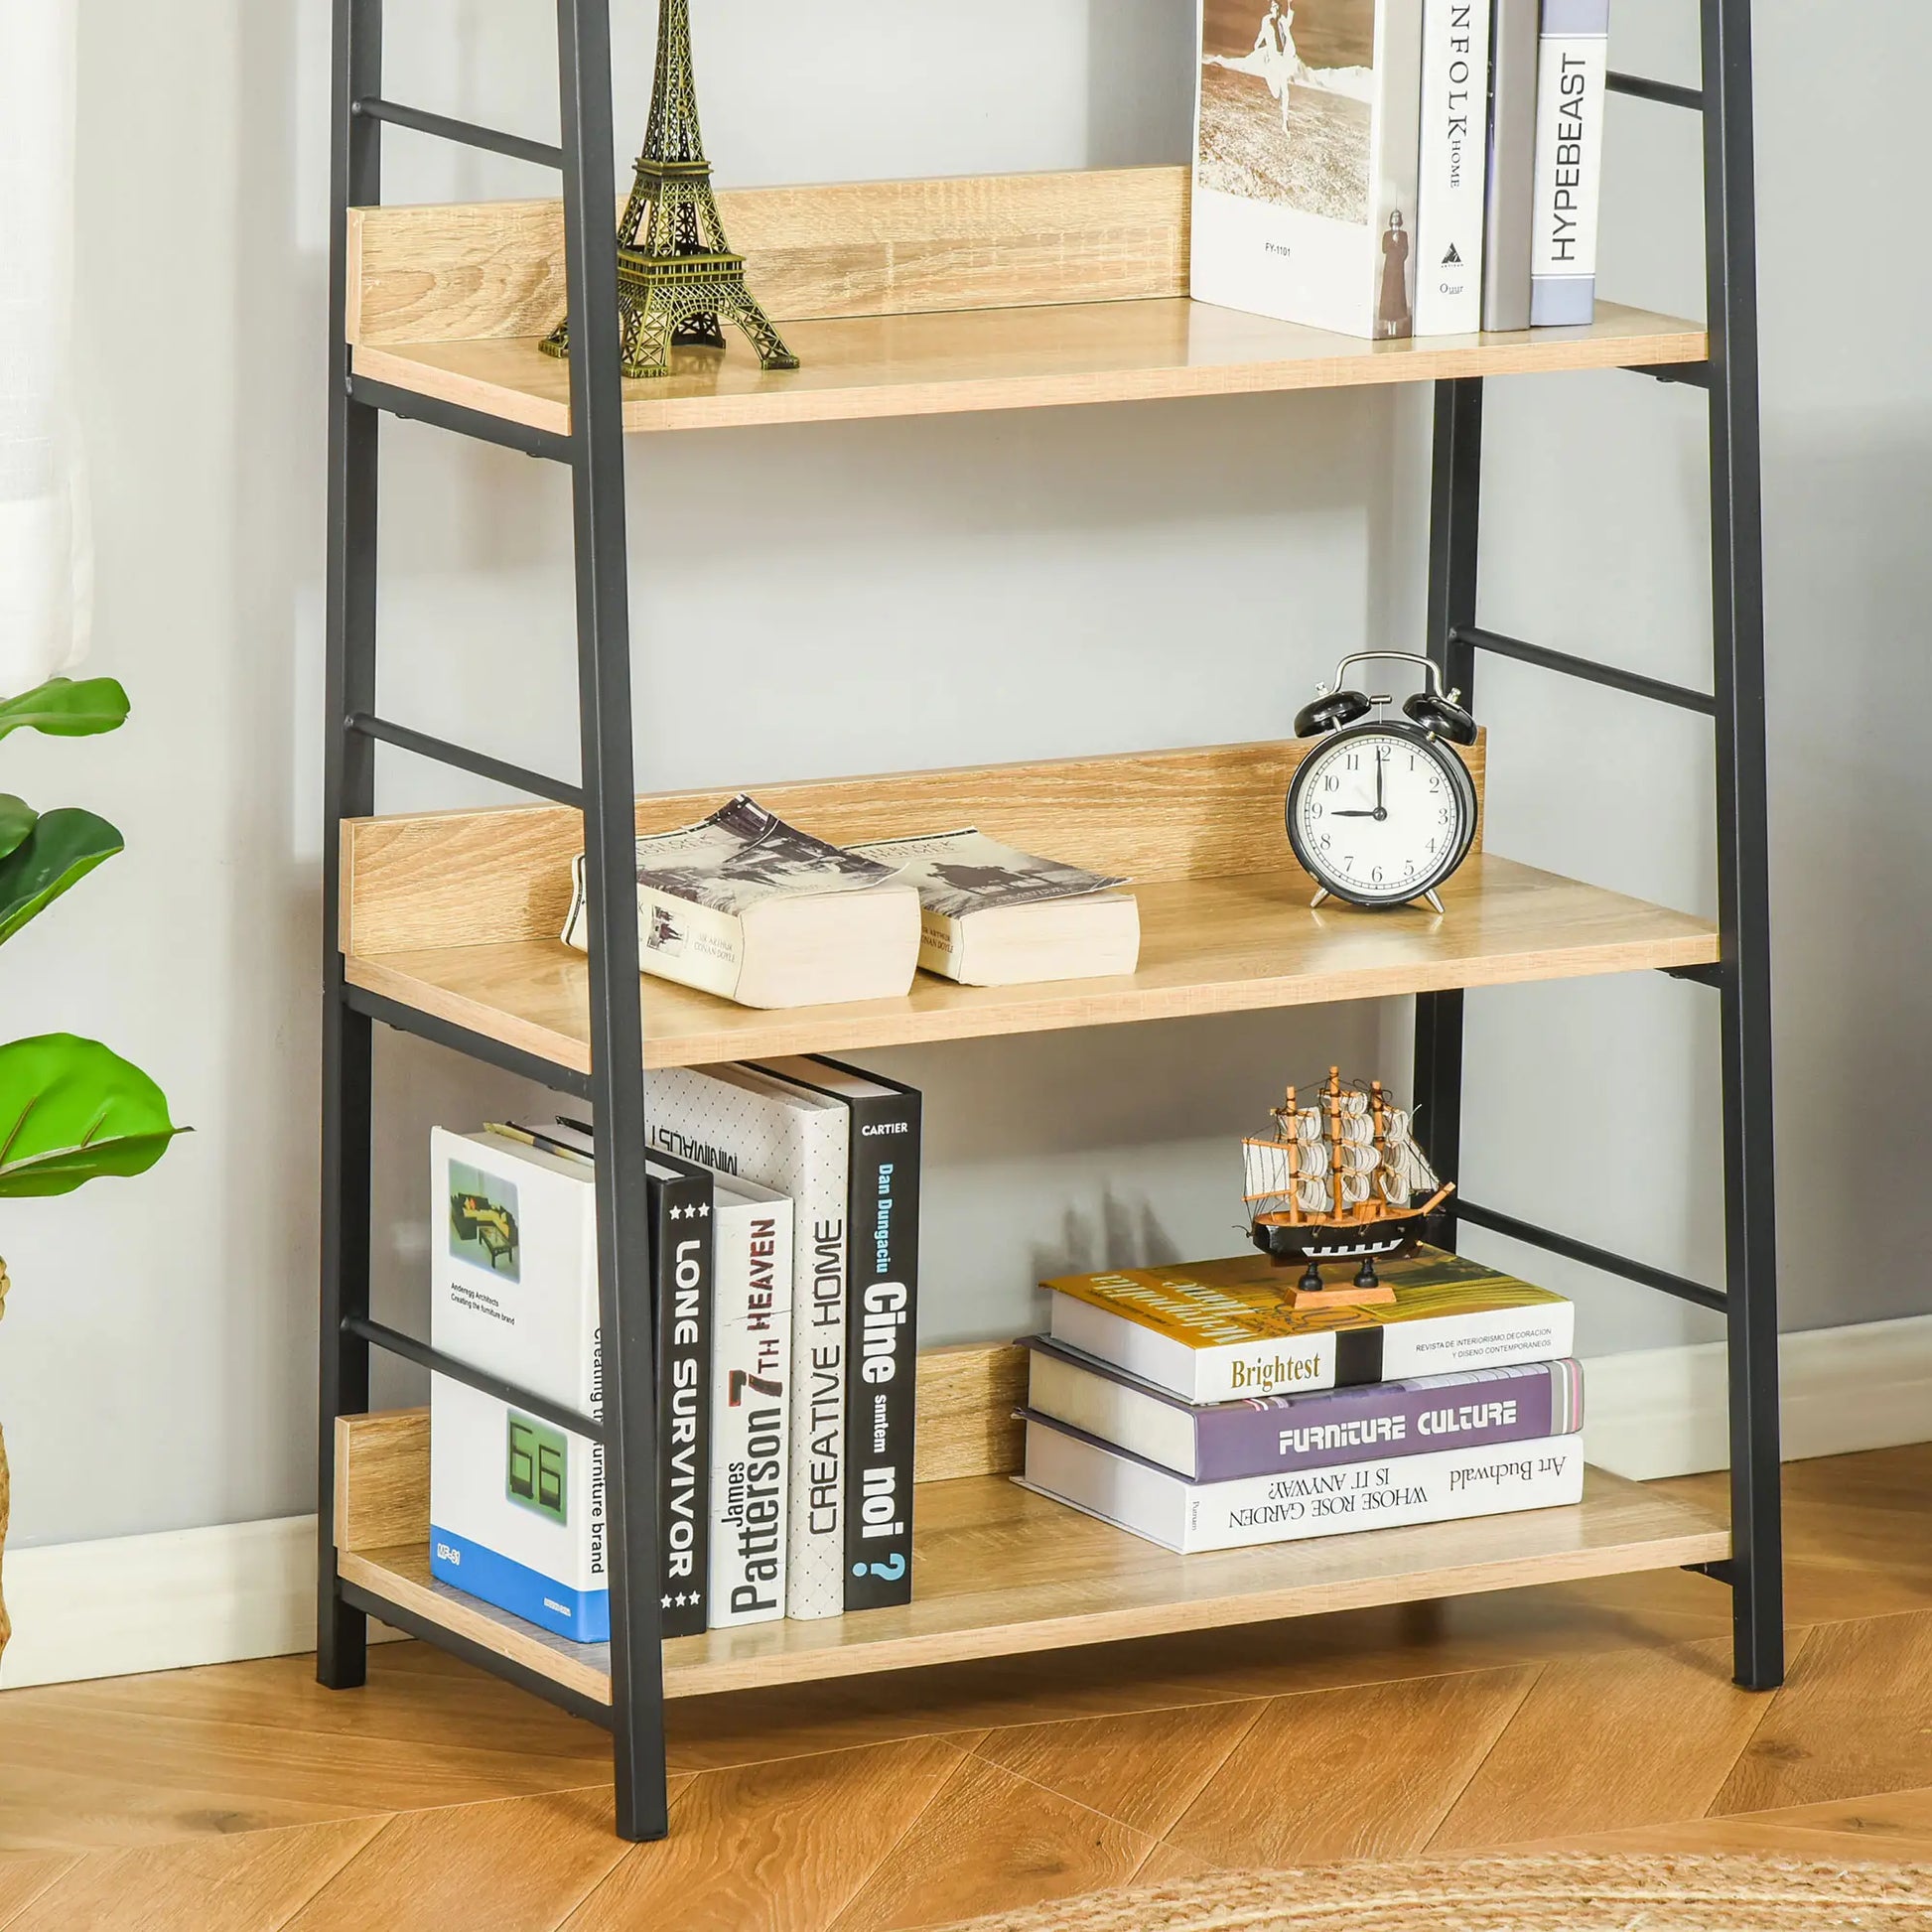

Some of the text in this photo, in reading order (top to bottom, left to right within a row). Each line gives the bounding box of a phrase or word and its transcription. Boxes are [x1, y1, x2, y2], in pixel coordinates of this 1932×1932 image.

[1448, 5, 1470, 189] NFOLK HOME
[1551, 52, 1587, 262] HYPEBEAST
[1265, 242, 1291, 257] FY-1101
[1346, 755, 1360, 770] 11
[1375, 745, 1392, 761] 12
[1409, 755, 1415, 771] 1
[1324, 775, 1339, 792] 10
[1429, 777, 1440, 794] 2
[1311, 802, 1322, 819] 9
[1438, 808, 1449, 825] 3
[1320, 834, 1331, 850] 8
[1425, 838, 1437, 854] 4
[1344, 856, 1354, 873] 7
[1371, 866, 1383, 883] 6
[1403, 860, 1414, 877] 5
[862, 1123, 908, 1137] CARTIER
[874, 1163, 894, 1274] Dan Dungaciu
[747, 1218, 775, 1331] HEAVEN
[451, 1293, 472, 1310] Creating
[500, 1312, 515, 1325] brand
[862, 1281, 908, 1384] Cine
[1416, 1340, 1445, 1352] REVISTA
[809, 1218, 842, 1535] CREATIVE HOME
[1230, 1351, 1321, 1393] Brightest
[668, 1240, 701, 1579] LONE SURVIVOR
[1279, 1400, 1518, 1455] FURNITURE CULTURE
[1267, 1467, 1390, 1499] IS IT ANYWAY?
[1449, 1456, 1567, 1491] Art Buchwald
[721, 1407, 780, 1613] James Patterson
[861, 1465, 904, 1539] noi
[1228, 1485, 1429, 1529] WHOSE ROSE GARDEN
[591, 1523, 605, 1574] brand
